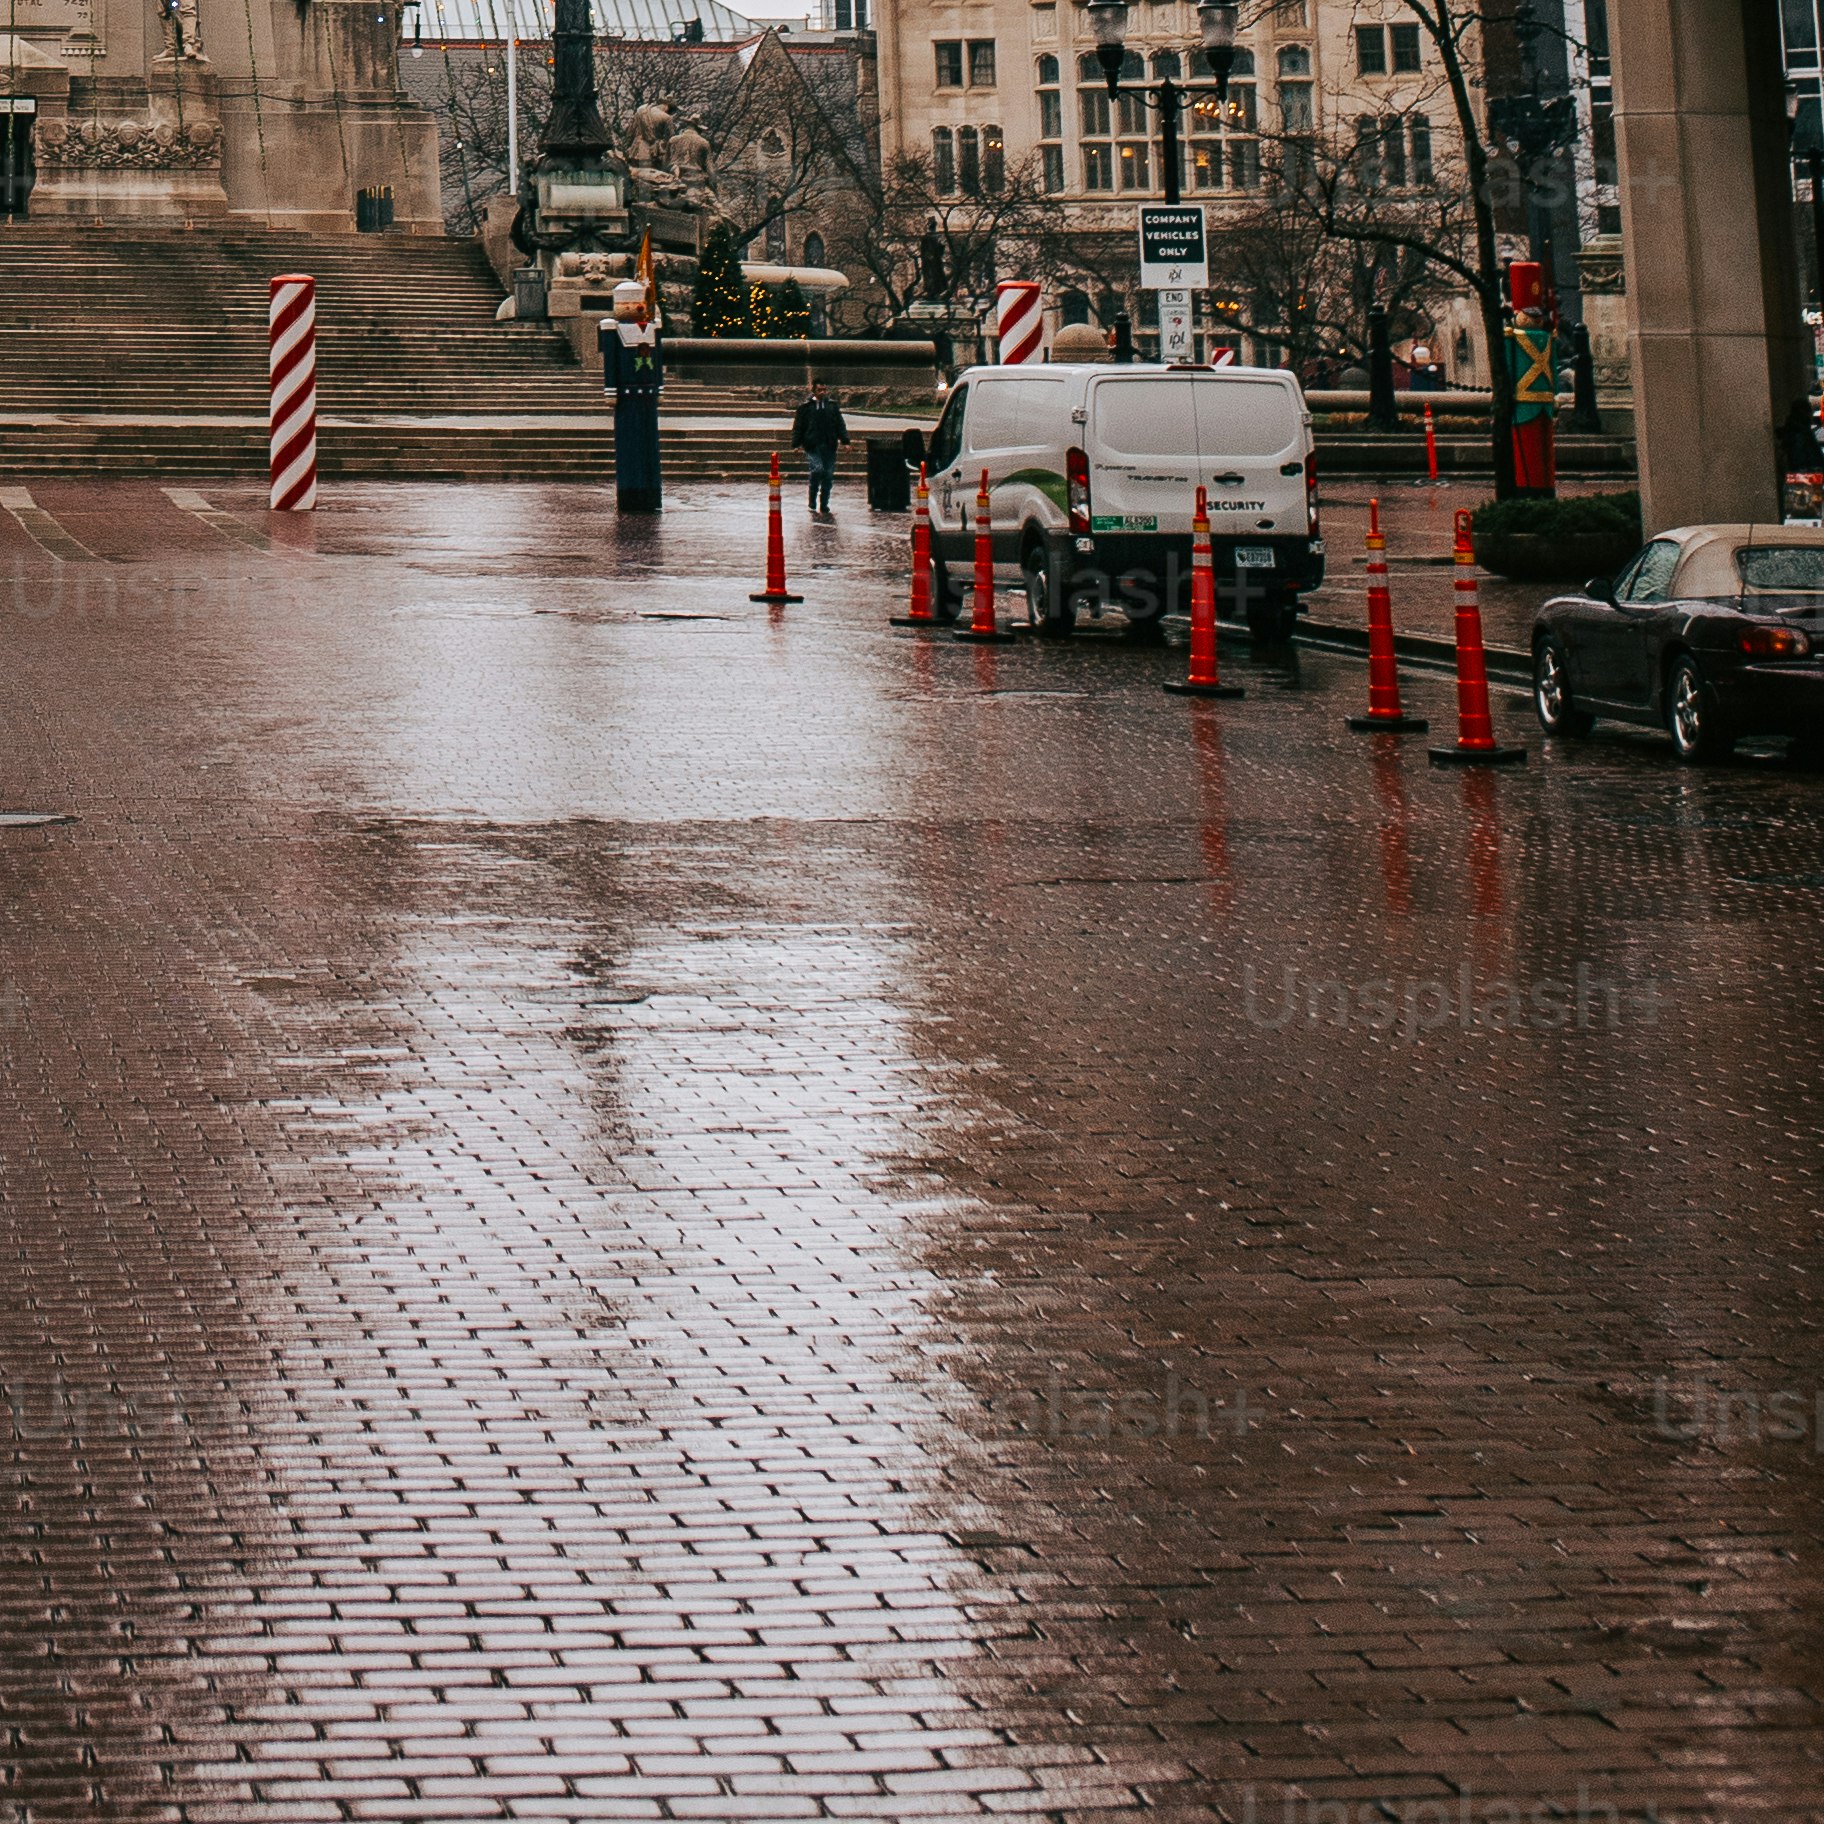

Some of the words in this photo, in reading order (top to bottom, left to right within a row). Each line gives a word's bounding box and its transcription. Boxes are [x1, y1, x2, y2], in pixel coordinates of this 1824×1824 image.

[1145, 215, 1198, 224] COMPANY
[1146, 231, 1199, 240] VEHICLES
[1158, 248, 1188, 256] ONLY
[1165, 293, 1183, 302] END
[1206, 501, 1265, 511] SECURITY
